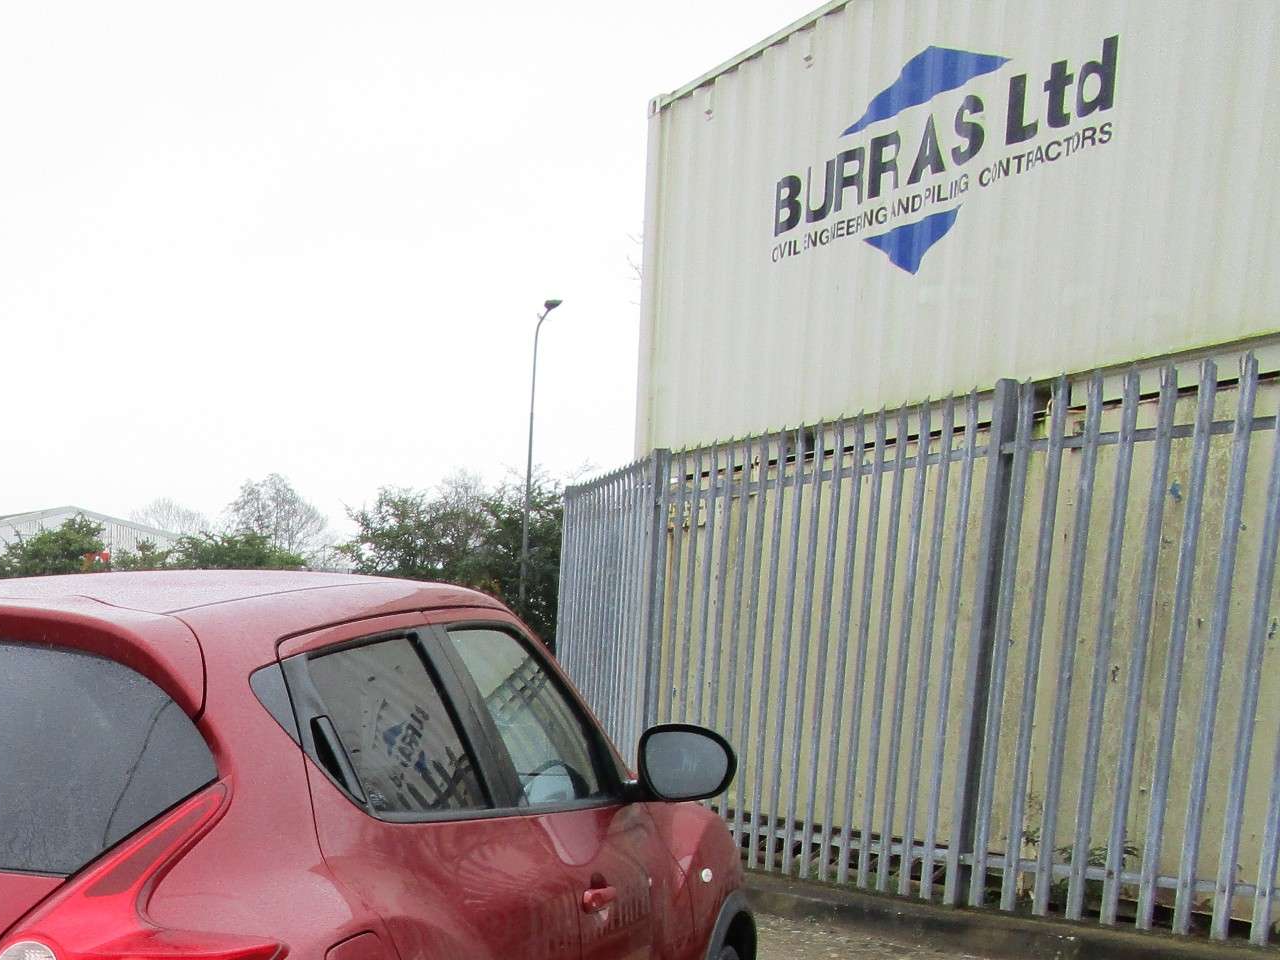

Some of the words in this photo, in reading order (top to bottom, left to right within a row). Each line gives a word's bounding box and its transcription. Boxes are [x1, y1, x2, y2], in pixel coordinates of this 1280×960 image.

[771, 240, 801, 263] CVIL
[803, 206, 888, 250] NGNEERNG
[978, 121, 1113, 188] CONTRACTORS
[773, 94, 986, 237] BURRAS
[1005, 33, 1120, 146] Ltd
